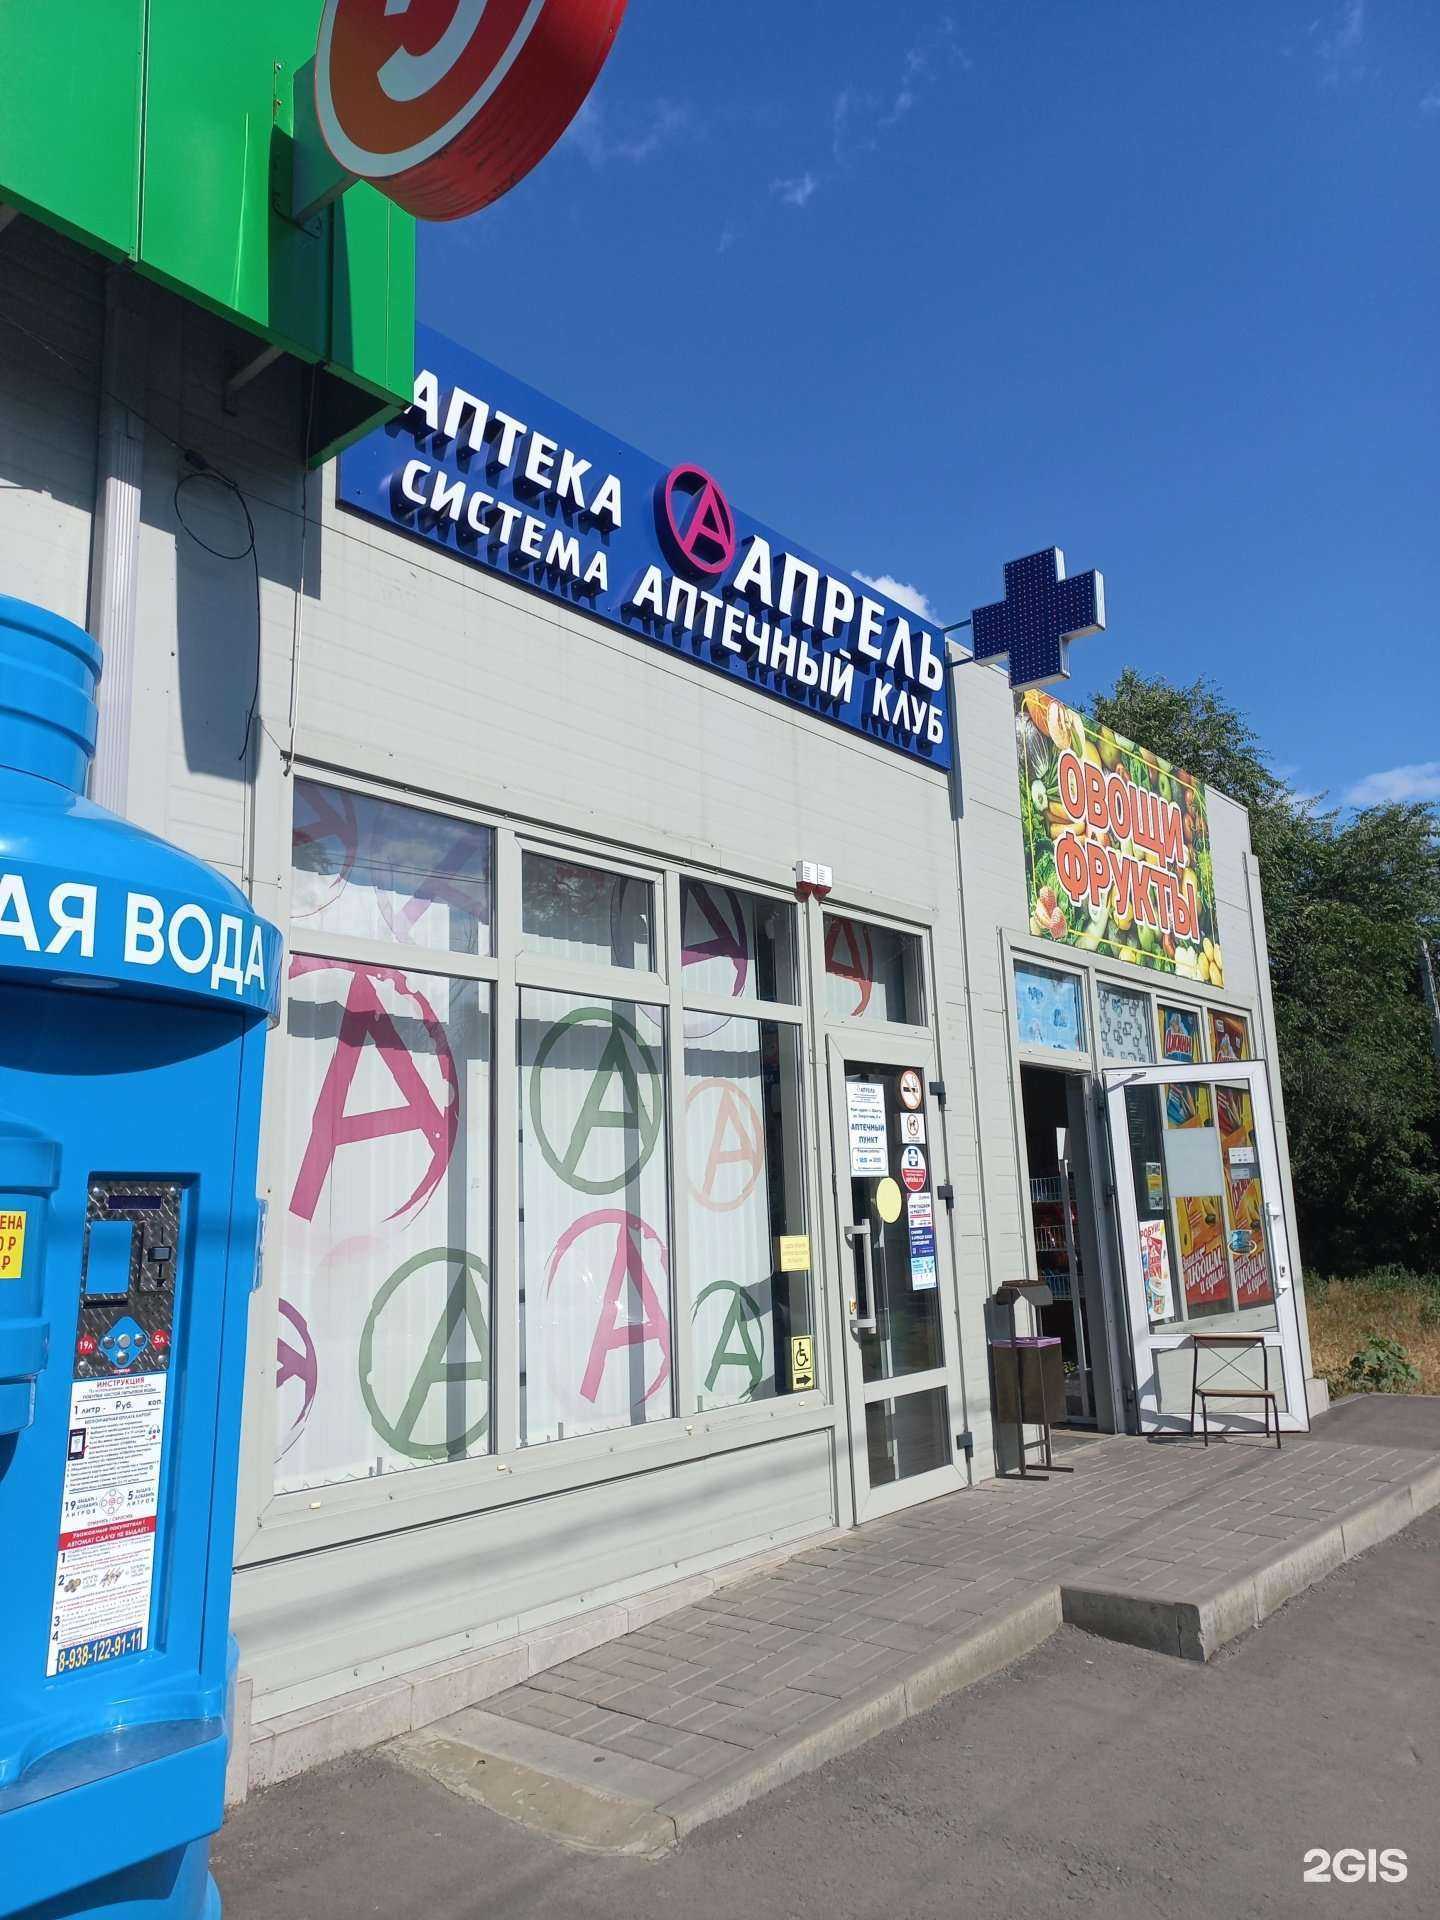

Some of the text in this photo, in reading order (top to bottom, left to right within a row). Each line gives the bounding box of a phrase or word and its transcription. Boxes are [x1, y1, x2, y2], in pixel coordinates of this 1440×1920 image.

[404, 369, 622, 528] АПТЕКА
[733, 535, 944, 692] АПРЕЛЬ
[401, 458, 944, 746] СИСТЕМА АПТЕЧНЫЙ КЛУБ
[1058, 751, 1187, 868] ОВОЩИ
[1055, 831, 1200, 941] ФРУКТЫ
[123, 892, 265, 996] ВОДА
[858, 1136, 879, 1144] ПУНКТ
[96, 1377, 145, 1388] ИНСТРУКЦИЯ
[127, 1491, 134, 1500] 5
[64, 1500, 76, 1511] 19
[61, 1552, 66, 1563] 1
[58, 1574, 65, 1586] 2
[53, 1615, 60, 1627] 3
[52, 1630, 59, 1641] 4
[58, 1629, 142, 1673] 8-938-122-91-11
